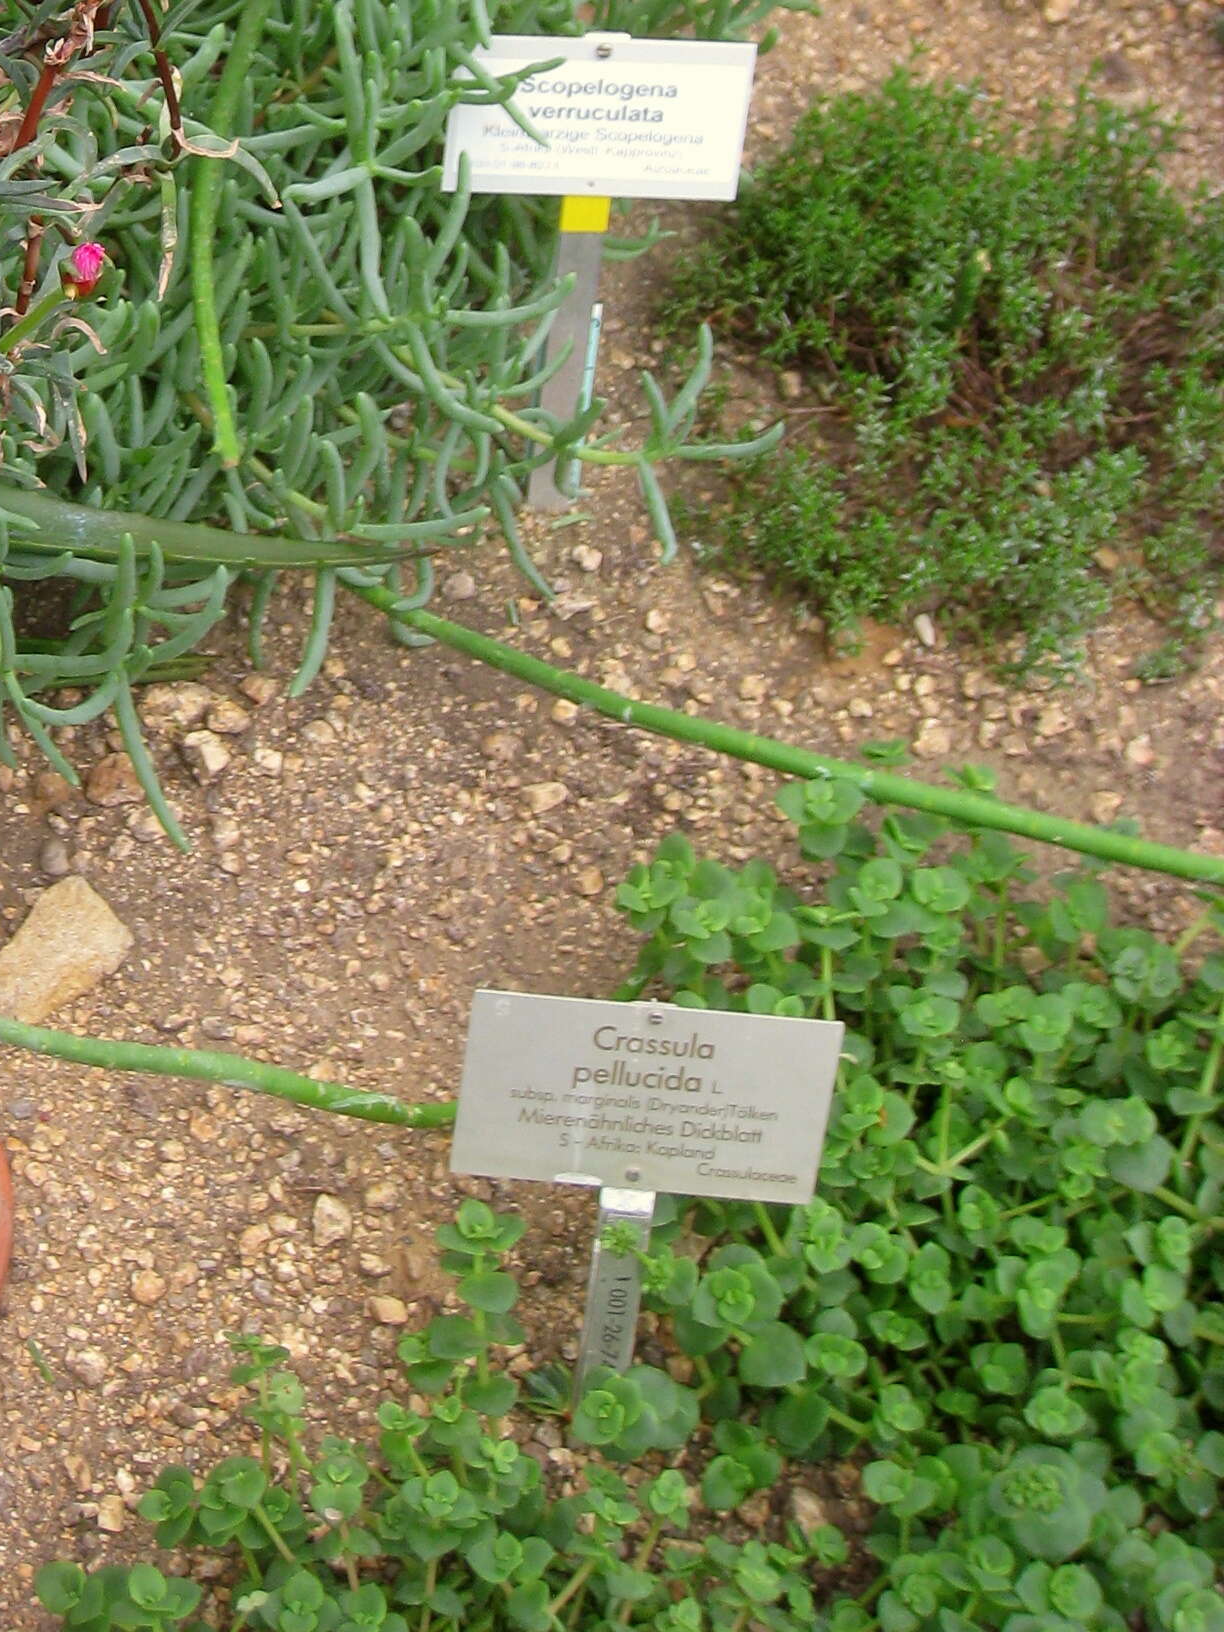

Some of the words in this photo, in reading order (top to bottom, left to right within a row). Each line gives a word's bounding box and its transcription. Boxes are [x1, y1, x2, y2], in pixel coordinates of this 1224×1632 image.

[520, 77, 678, 100] Scopelogena
[529, 104, 664, 124] verruculata
[593, 1025, 716, 1060] Crassula
[572, 1059, 702, 1093] pellucida
[510, 1086, 557, 1103] subsp.
[562, 1093, 641, 1110] marginalis
[517, 1107, 674, 1136] Mierenähnliches
[680, 1120, 763, 1144] Dickblatt
[647, 1141, 716, 1160] Kapland
[696, 1162, 798, 1184] Crassulaceae
